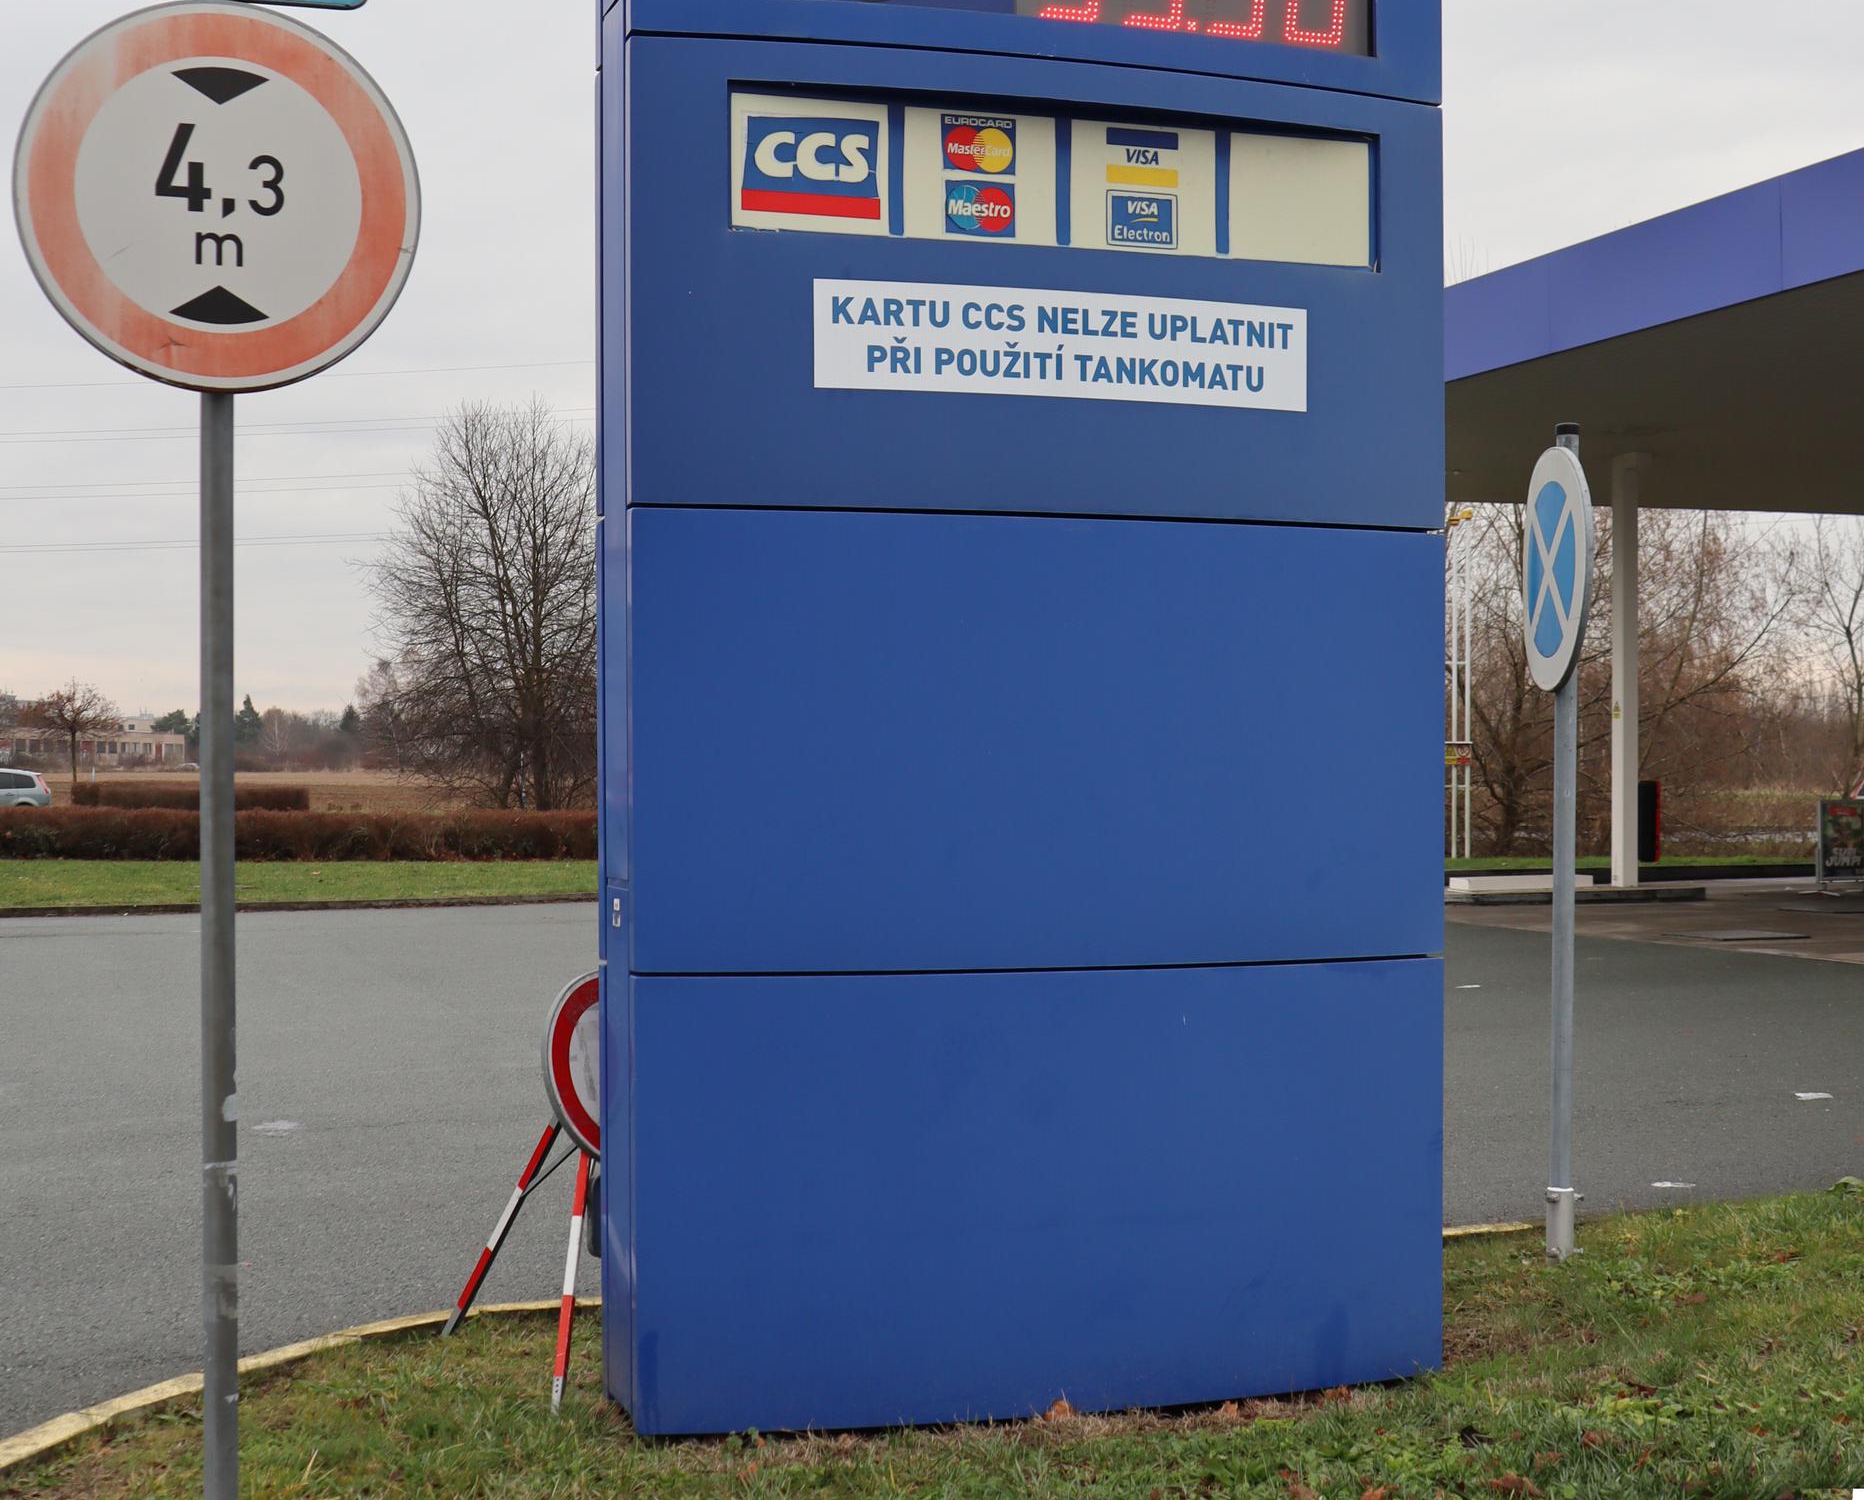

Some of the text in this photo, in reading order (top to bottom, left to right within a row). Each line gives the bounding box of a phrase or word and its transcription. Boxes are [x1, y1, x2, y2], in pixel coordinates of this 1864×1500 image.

[944, 115, 1013, 130] EUROCARD
[754, 131, 870, 184] CCS
[947, 142, 1011, 158] MasterCard
[1125, 148, 1160, 166] VISA
[155, 122, 285, 219] 4,3
[948, 198, 1012, 219] Maestro
[1126, 200, 1159, 216] VISA
[1113, 224, 1171, 243] Electron
[195, 231, 243, 267] m
[832, 296, 1293, 350] KARTU CCS NELZE UPLATNIT
[867, 337, 1264, 393] PŘI POUŽITÍ TANKOMATU
